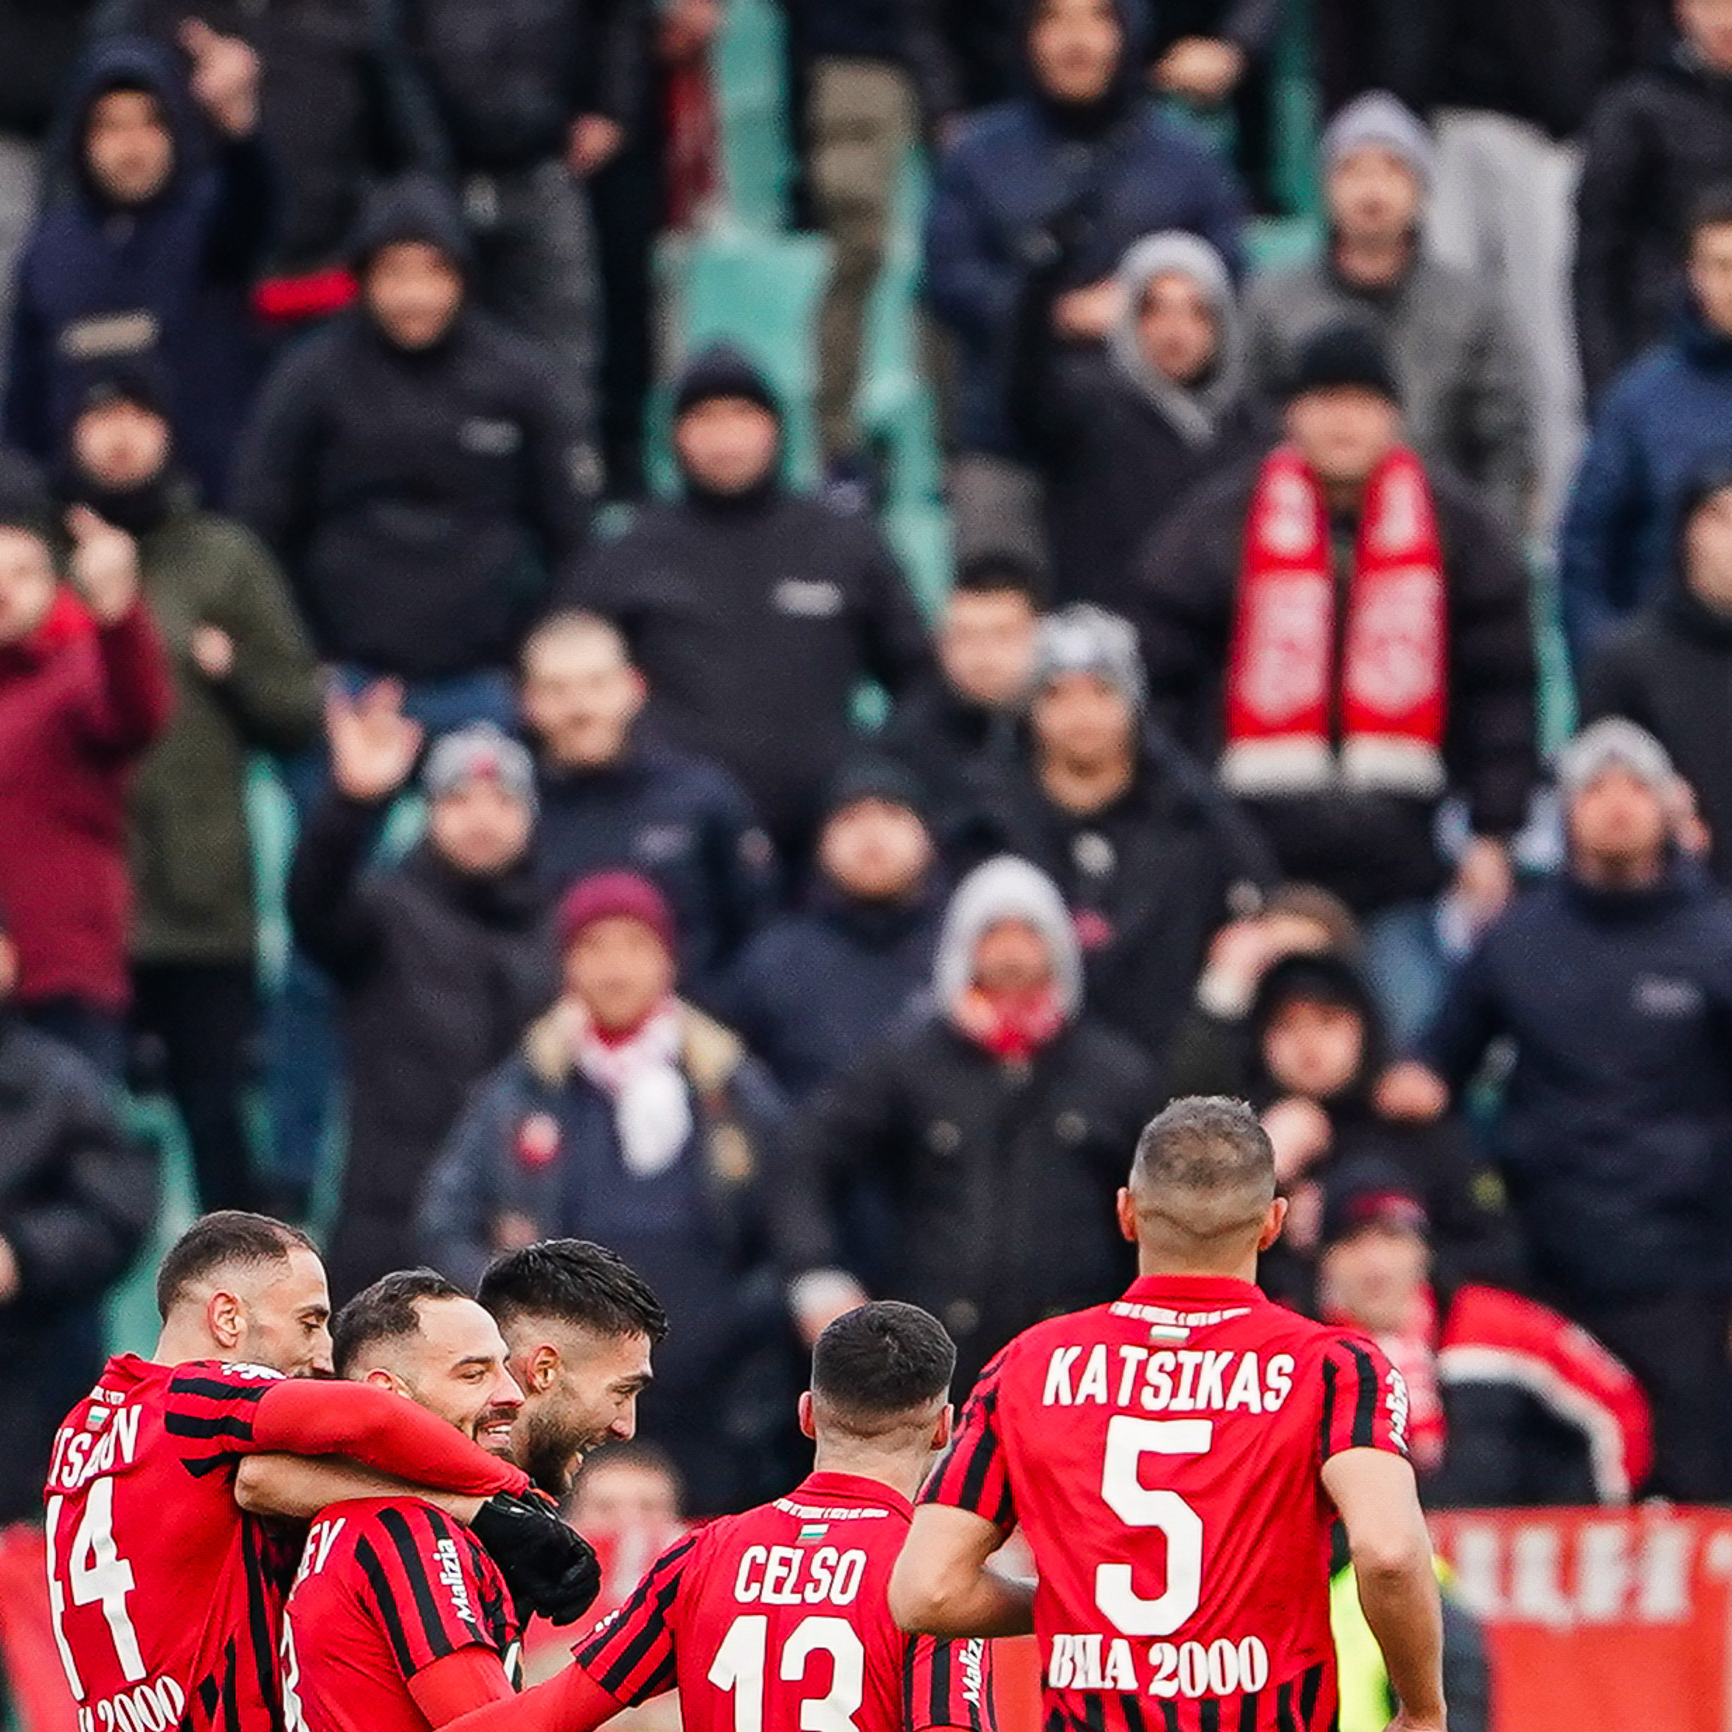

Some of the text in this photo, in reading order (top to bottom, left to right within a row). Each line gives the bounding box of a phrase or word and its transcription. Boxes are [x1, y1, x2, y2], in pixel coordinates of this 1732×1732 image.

[1042, 1344, 1296, 1414] KATSIKAS
[1095, 1414, 1214, 1636] 5
[432, 1538, 476, 1624] Malizia
[733, 1545, 868, 1606] CELSO
[1147, 1635, 1268, 1699] 2000
